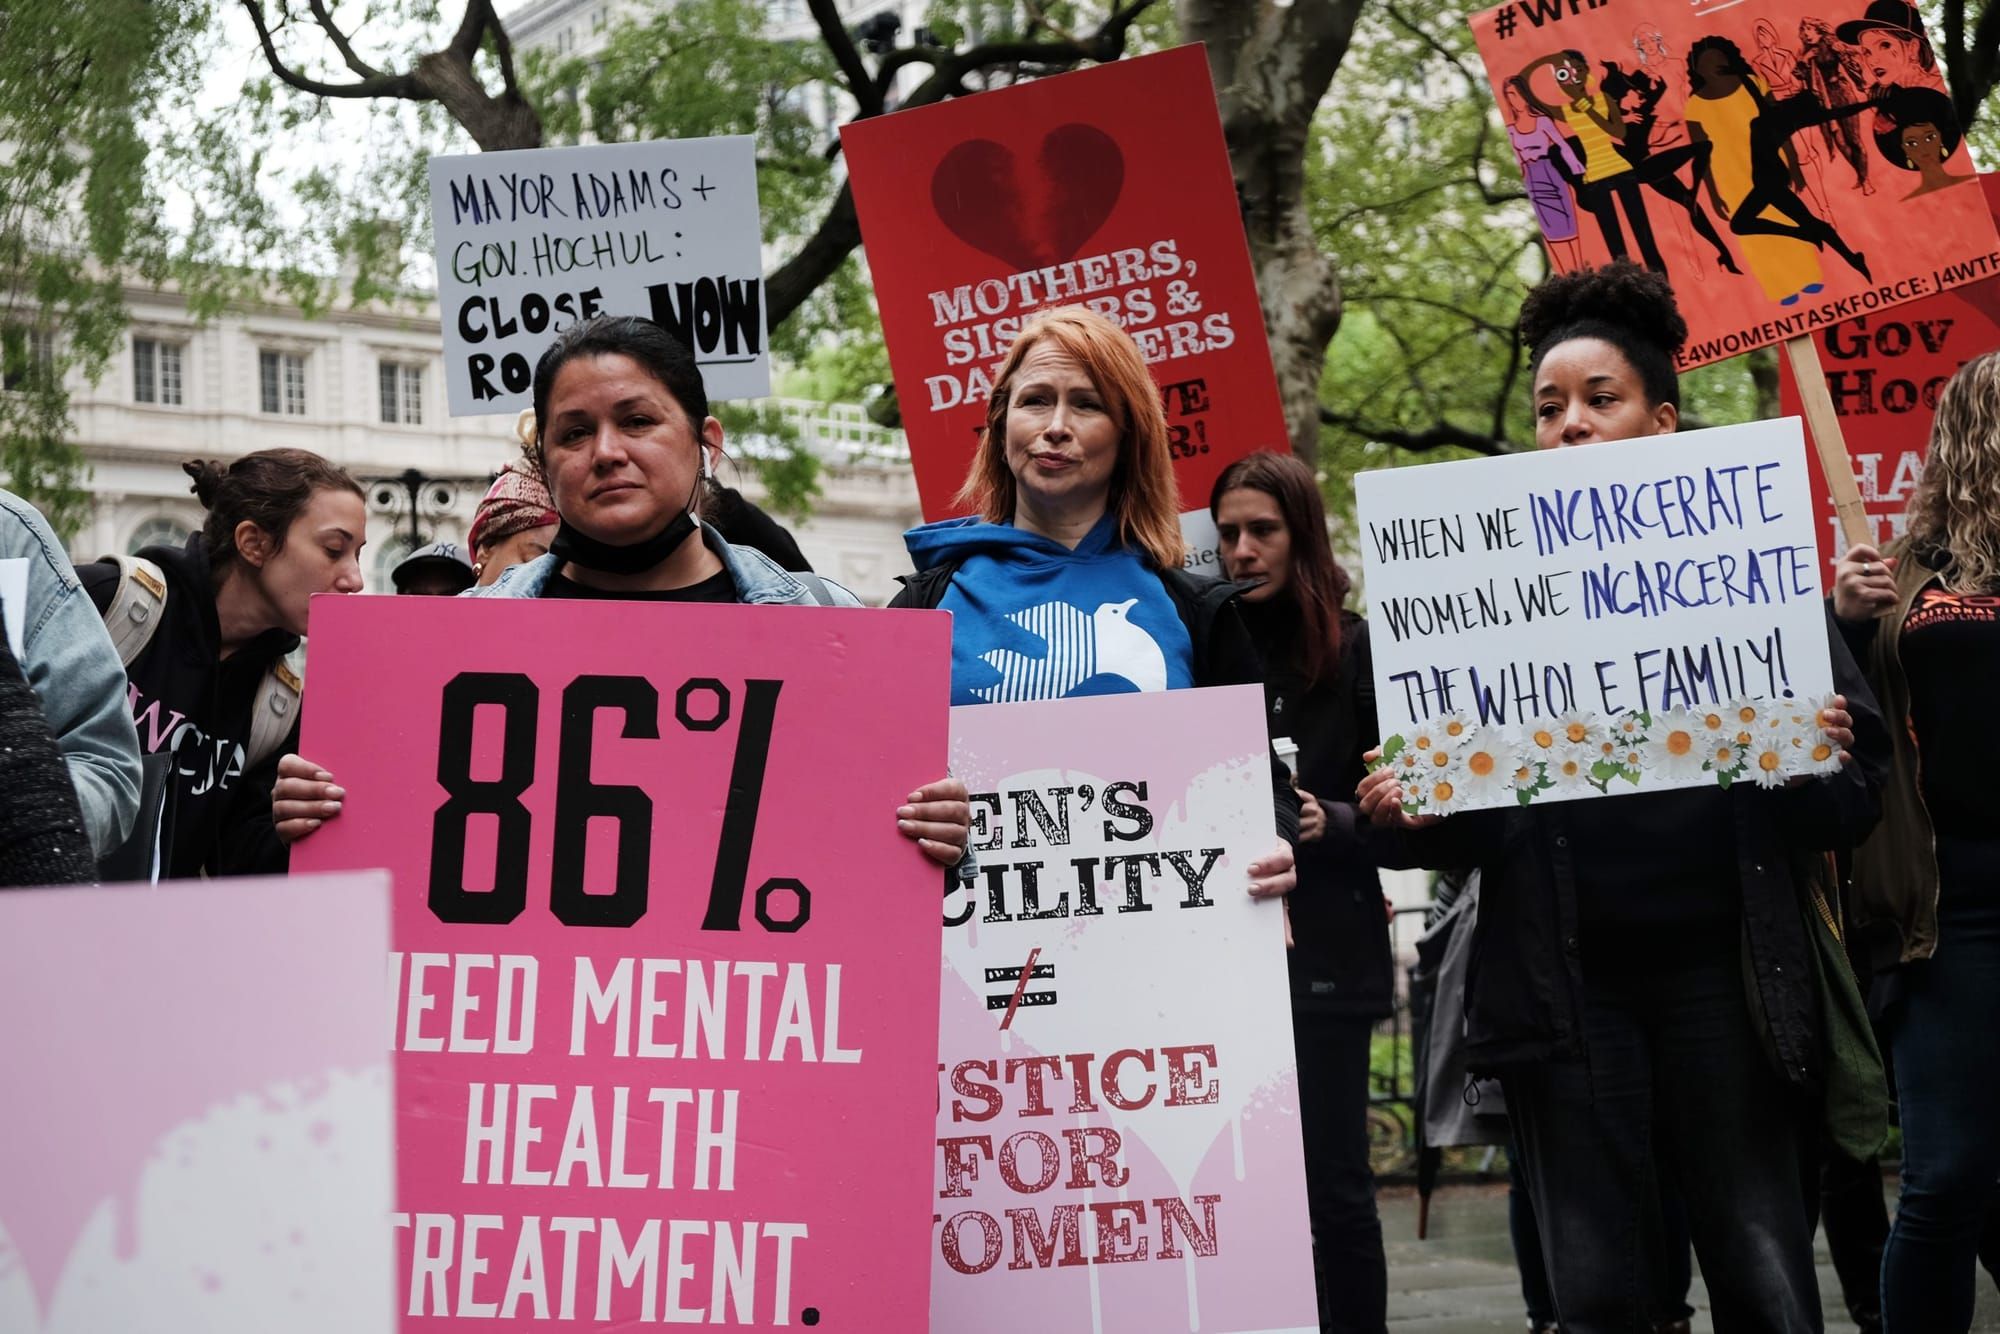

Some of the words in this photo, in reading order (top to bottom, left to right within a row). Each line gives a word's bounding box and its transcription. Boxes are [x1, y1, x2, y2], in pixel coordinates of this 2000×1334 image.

[450, 173, 569, 225] MAYOR
[572, 168, 683, 221] ADAMS
[452, 240, 528, 287] GOV.
[928, 239, 1198, 328] MOTHERS,
[458, 286, 606, 344] CLOSE
[643, 274, 761, 356] NOW
[943, 287, 1157, 366] SISRS
[1165, 279, 1202, 317] &
[1676, 277, 1930, 369] E4WOMENTASKFORCE:
[1933, 252, 2000, 294] J4WTF
[1824, 315, 1955, 360] Gov
[1369, 514, 1465, 564] WHEN
[1476, 508, 1524, 552] WE
[1529, 462, 1783, 556] INCARCERATE
[1382, 578, 1513, 642] WOMEN,
[1514, 570, 1573, 623] WE
[1582, 546, 1815, 620] INCARCERATE
[1389, 665, 1464, 724] THE
[1468, 661, 1625, 727] WHOLE
[1634, 627, 1795, 711] FAMILY!
[428, 671, 811, 933] 86%
[968, 780, 1154, 851] EN'S
[569, 956, 863, 1064] MENTAL
[937, 1044, 1220, 1123] STICE
[462, 1083, 740, 1191] HEALTH
[937, 1126, 1131, 1198] FOR
[933, 1194, 1221, 1275] OMEN
